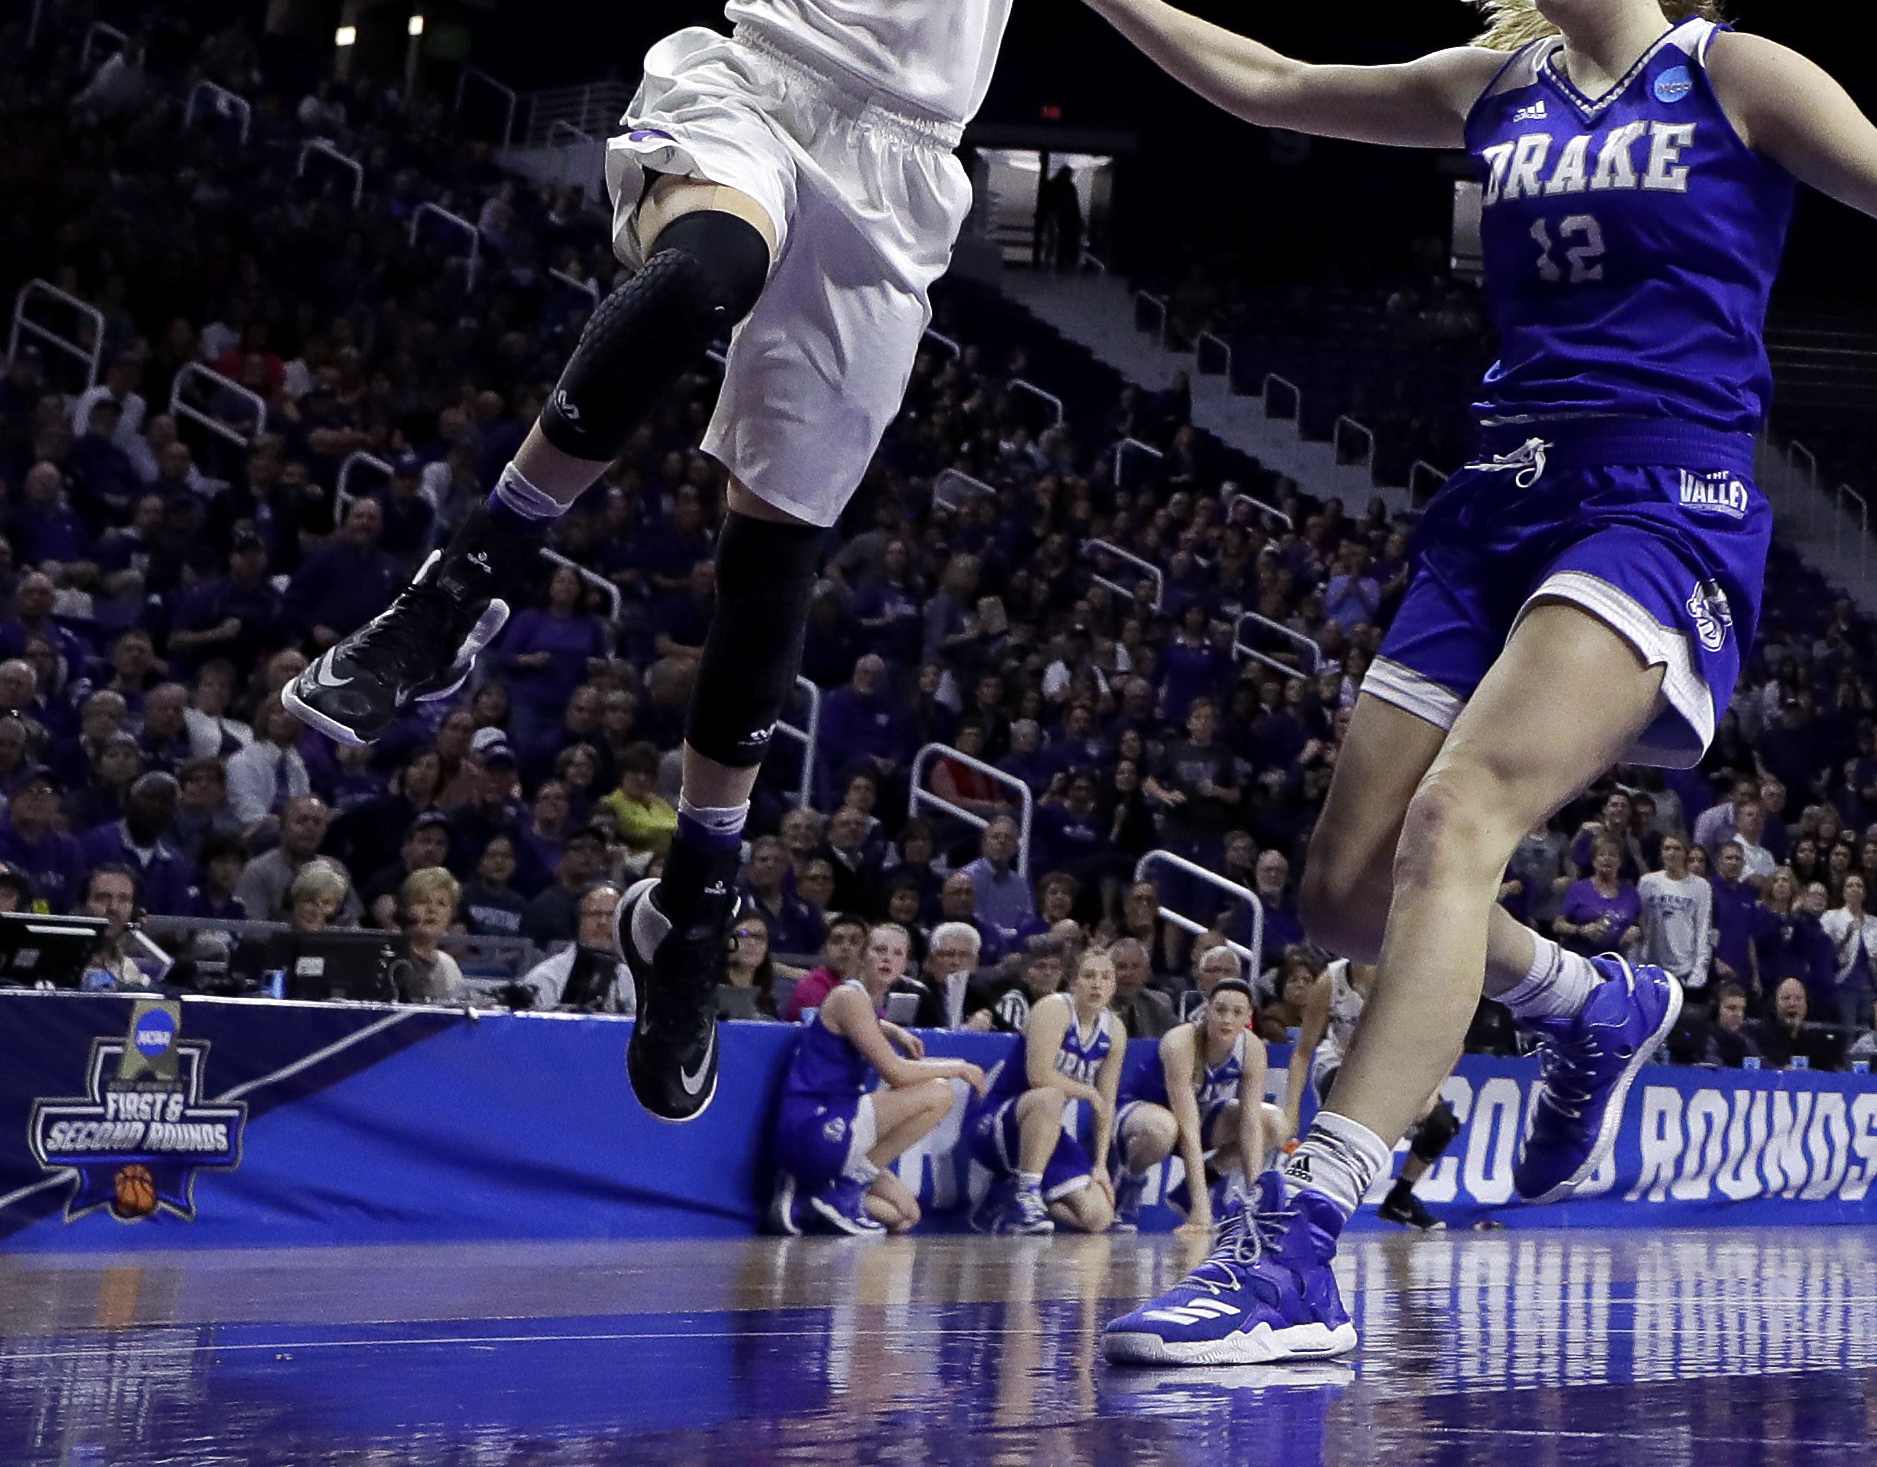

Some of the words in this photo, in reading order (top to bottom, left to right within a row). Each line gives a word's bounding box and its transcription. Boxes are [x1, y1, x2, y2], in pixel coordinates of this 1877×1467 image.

[1482, 120, 1697, 207] DRAKE
[1530, 213, 1607, 284] 12
[1705, 470, 1729, 481] THE
[105, 1092, 167, 1122] FIRST
[47, 1120, 146, 1151] SECOND
[144, 1122, 229, 1152] ROUNDS
